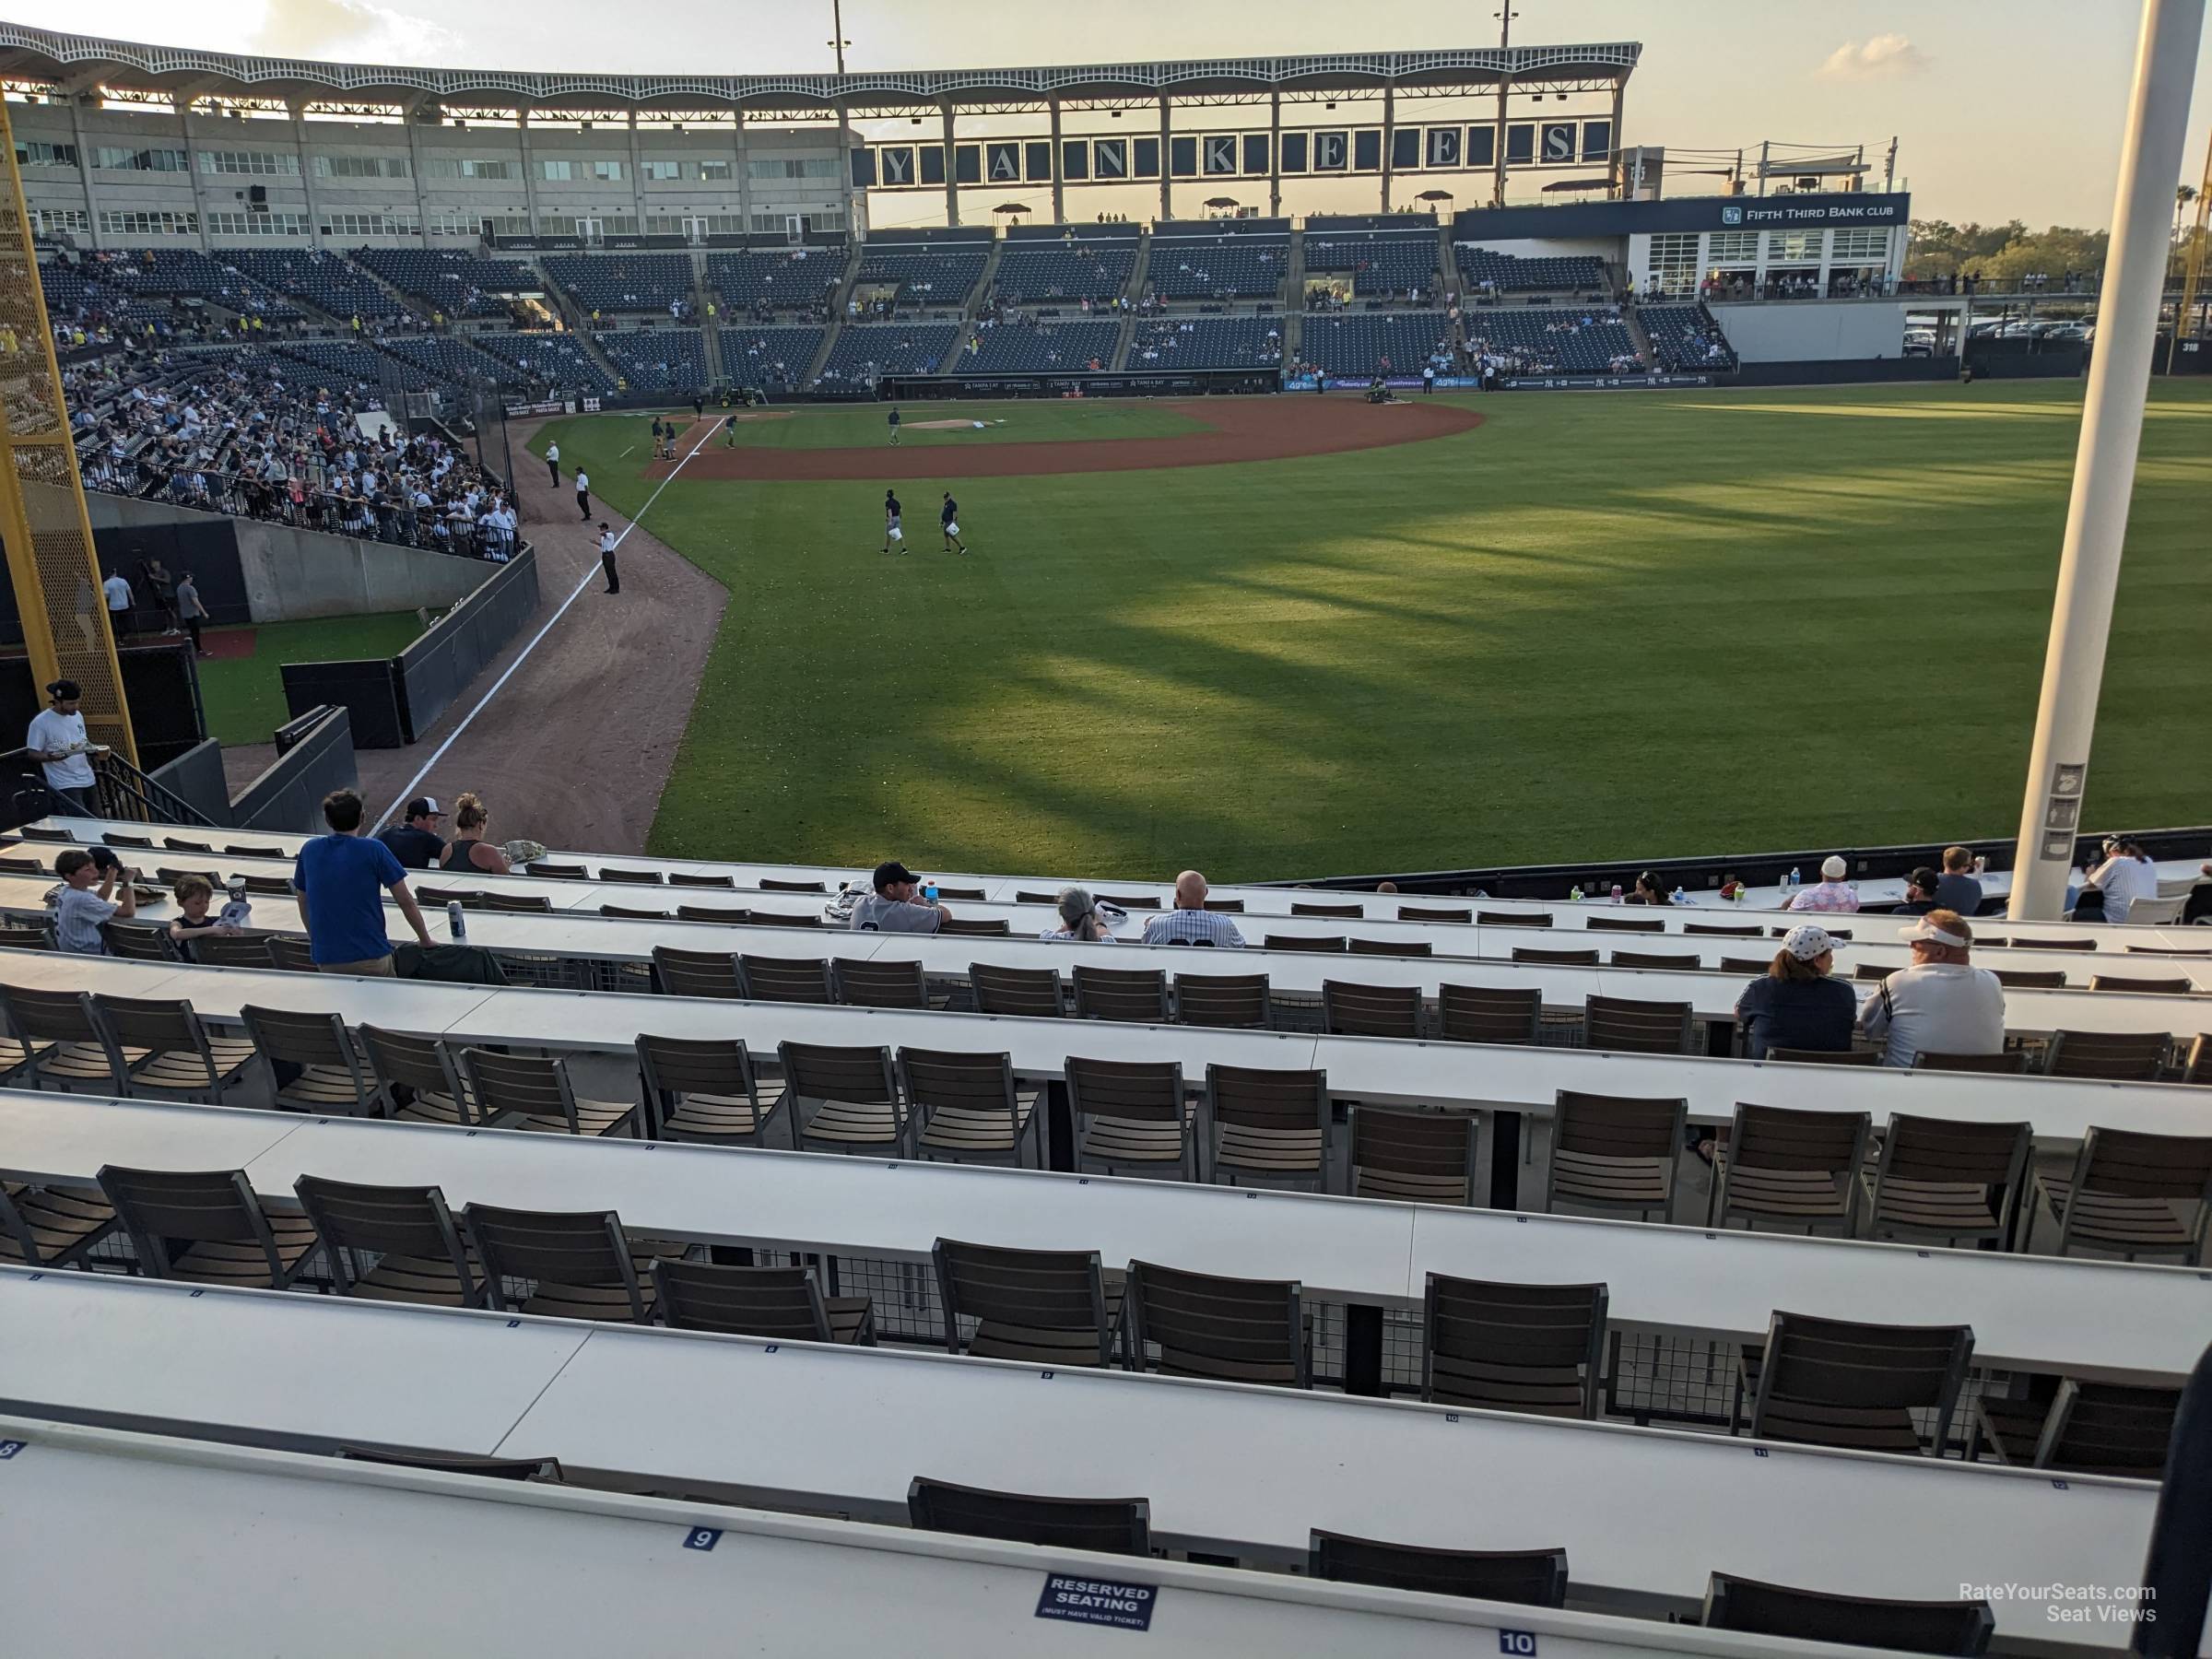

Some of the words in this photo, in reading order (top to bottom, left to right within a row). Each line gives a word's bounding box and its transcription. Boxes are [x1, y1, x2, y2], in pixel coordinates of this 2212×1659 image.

[883, 125, 1571, 182] YANKEES
[1747, 210, 1783, 220] FIFTH
[1786, 208, 1825, 218] THIRD
[1829, 207, 1864, 218] BANK
[1866, 206, 1893, 216] CLUB
[0, 1442, 18, 1456] 8
[1755, 1448, 1767, 1456] 11
[693, 1531, 712, 1547] 9
[1051, 1578, 1149, 1600] RESERVED
[1055, 1592, 1138, 1612] SEATING
[1041, 1607, 1067, 1616] (MUST
[1067, 1609, 1088, 1618] HAVE
[1089, 1612, 1112, 1621] VALID
[1114, 1616, 1144, 1627] TICKET)
[1502, 1633, 1534, 1653] 10
